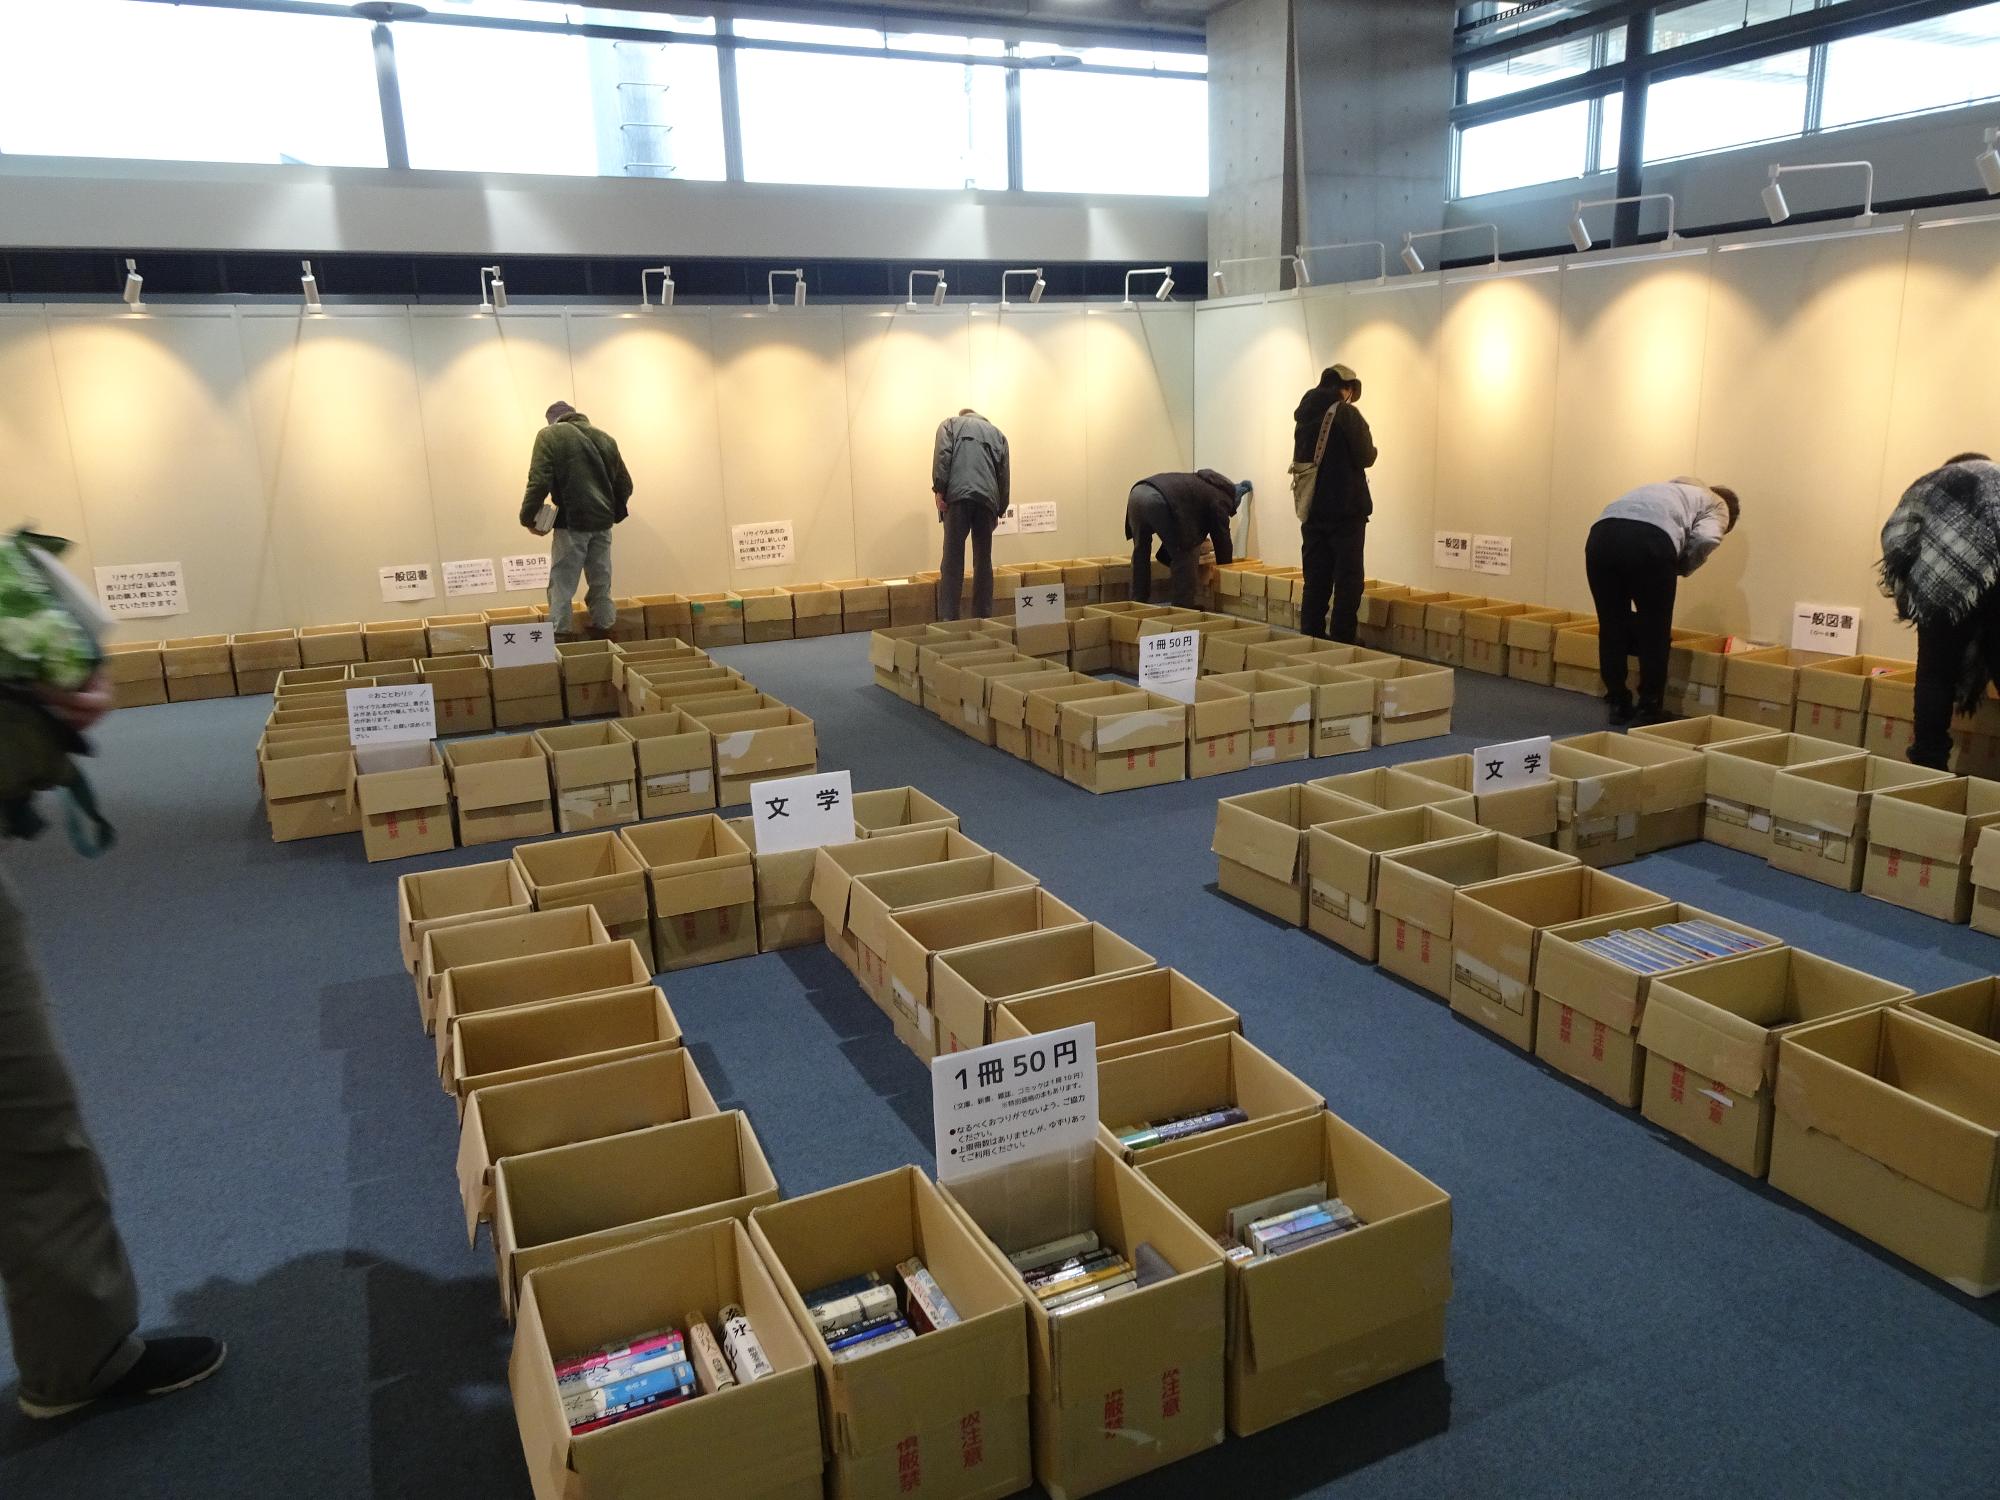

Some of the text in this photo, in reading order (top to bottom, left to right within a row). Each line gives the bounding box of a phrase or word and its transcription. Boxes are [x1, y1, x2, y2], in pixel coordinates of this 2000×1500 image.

[1437, 537, 1468, 550] 一般図書
[383, 569, 429, 583] 一般図書
[1798, 611, 1854, 630] 一般図書
[1148, 635, 1192, 650] 1冊50円
[953, 1039, 1078, 1091] 1冊50円
